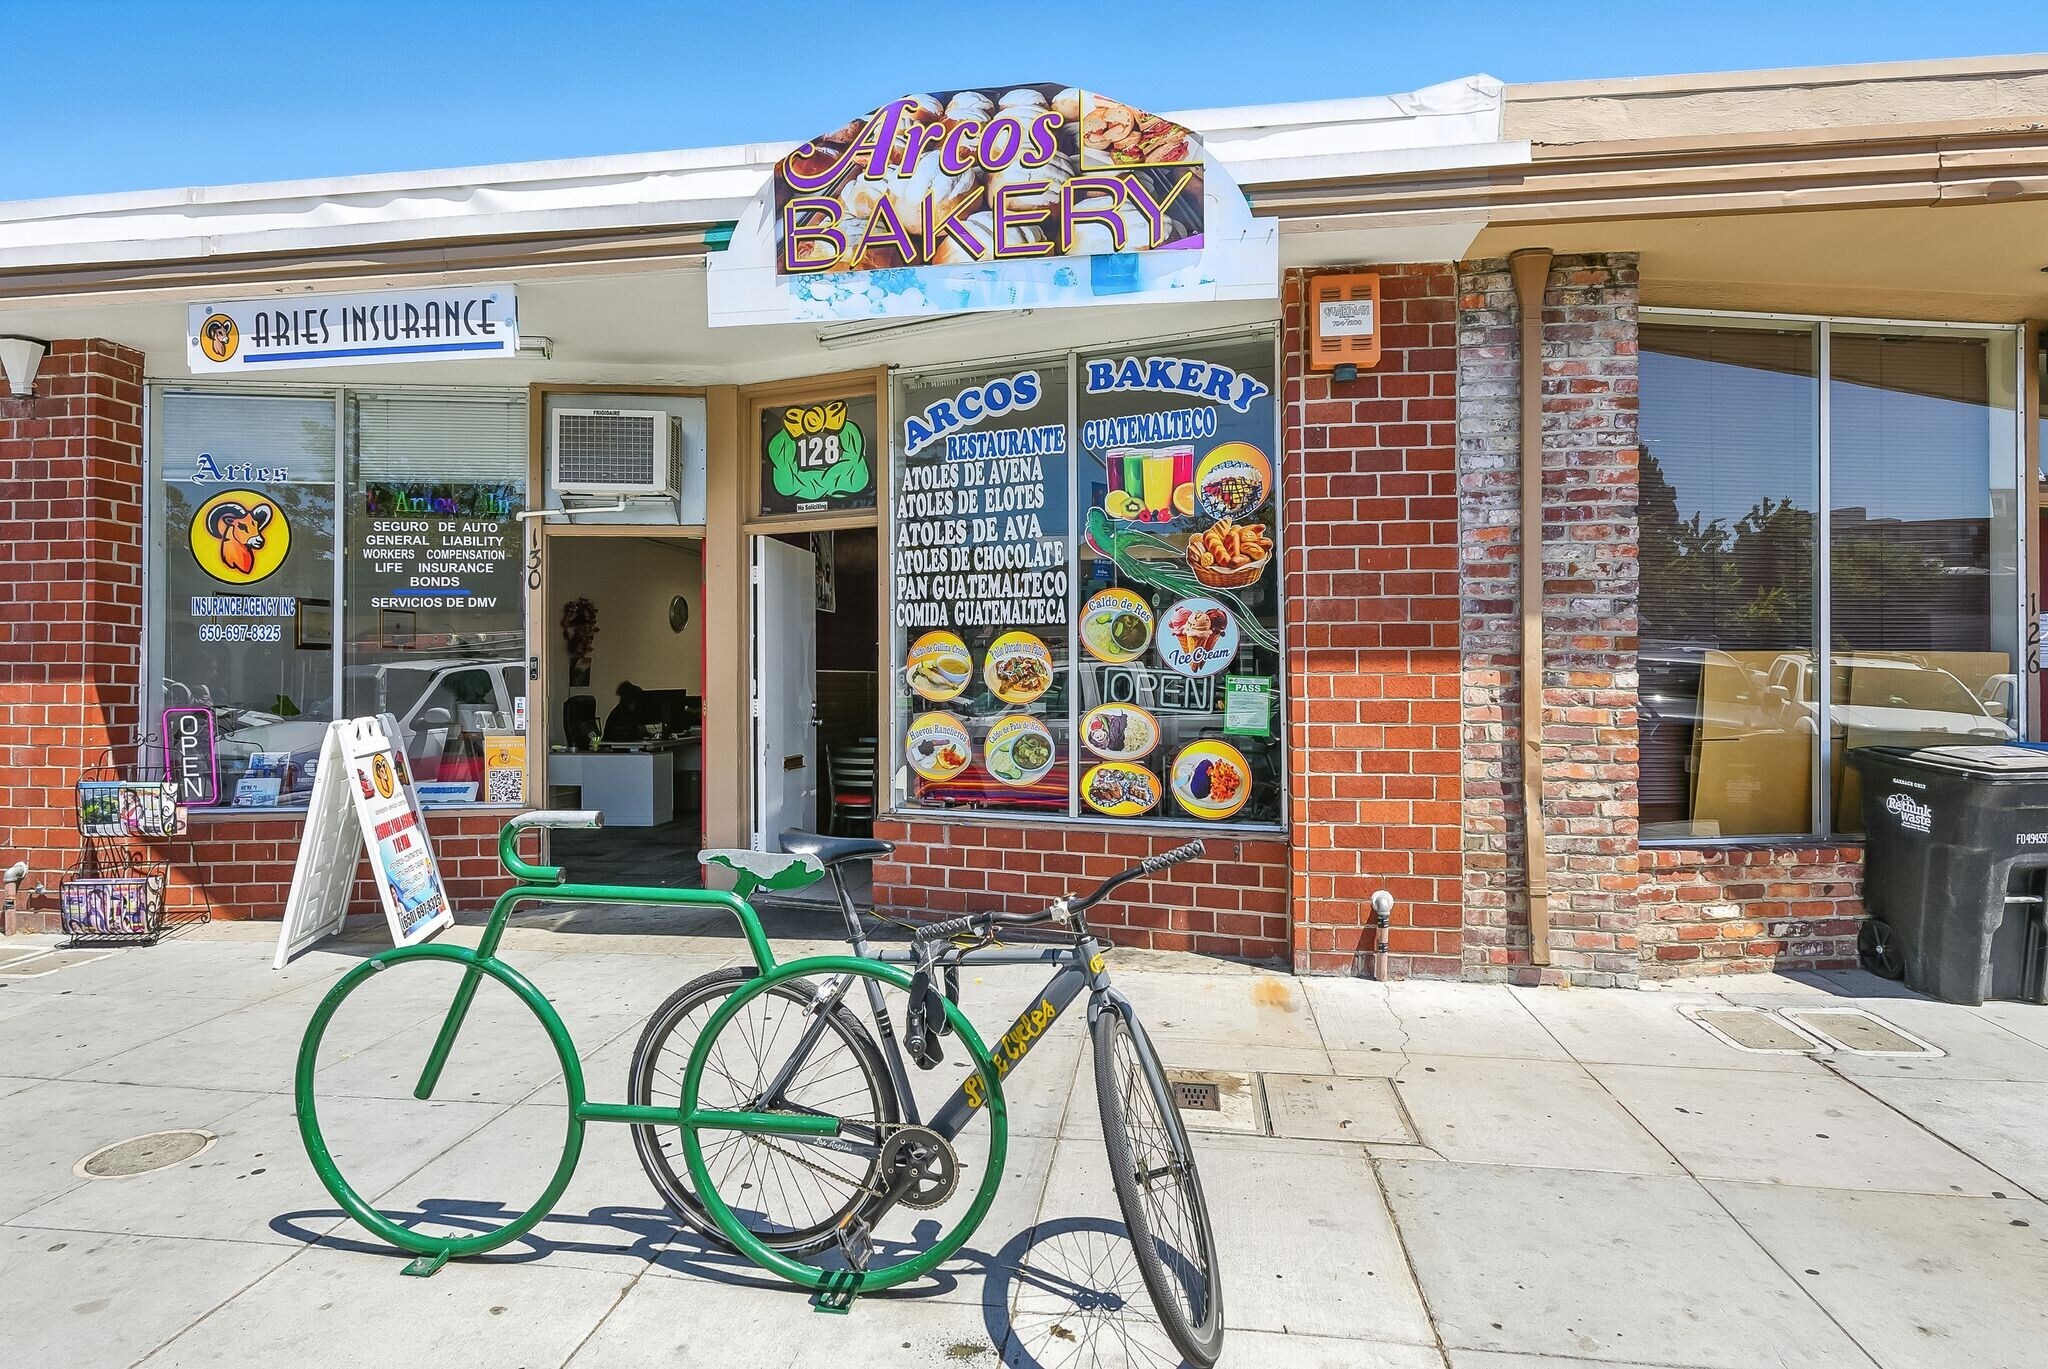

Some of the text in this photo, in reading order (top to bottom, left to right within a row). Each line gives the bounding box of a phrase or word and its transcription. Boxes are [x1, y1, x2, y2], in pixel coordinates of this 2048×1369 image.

[783, 99, 1064, 192] Arcos
[785, 171, 1193, 272] BAKERY
[251, 299, 496, 347] ARIES INSURANCE
[905, 358, 1267, 454] ARCOS BAKERY
[947, 407, 1216, 461] RESTAURANTE GUATEMALTECO
[798, 435, 840, 467] 128
[191, 453, 288, 485] Aries
[902, 456, 1044, 491] ATOLES DE AVENA
[797, 504, 805, 512] No
[897, 483, 1044, 519] ATOLES DE ELOTES
[366, 535, 504, 547] GENERAL LIABILITY
[373, 521, 498, 533] SEGURO DE AUTO
[897, 513, 1043, 547] ATOLES DE AVA
[363, 549, 505, 560] WORKERS COMPENSATION
[375, 562, 494, 573] LIFE INSURANCE
[527, 527, 541, 590] 130
[896, 541, 1064, 575] ATOLES DE CHOCOLATE
[410, 576, 460, 587] BONDS
[897, 571, 1067, 601] PAN GUATEMALTECO
[192, 597, 295, 616] INSURANCE AGENCY INC
[371, 597, 497, 608] SERVICIOS DE DMV
[896, 598, 1067, 628] COMIDA GUATEMALTECA
[1088, 597, 1152, 623] Caldo de Res
[200, 624, 281, 642] 650-697-8325
[2028, 592, 2041, 674] 126
[1169, 647, 1231, 665] Ice Cream
[1110, 671, 1208, 709] OPEN
[1235, 684, 1261, 692] PASS
[909, 724, 967, 742] Huevos Rancheros
[180, 715, 203, 798] OPEN
[1888, 796, 1932, 818] Rethink
[1900, 811, 1932, 827] waste
[1002, 999, 1057, 1060] Cycles
[827, 1140, 853, 1152] Angeles
